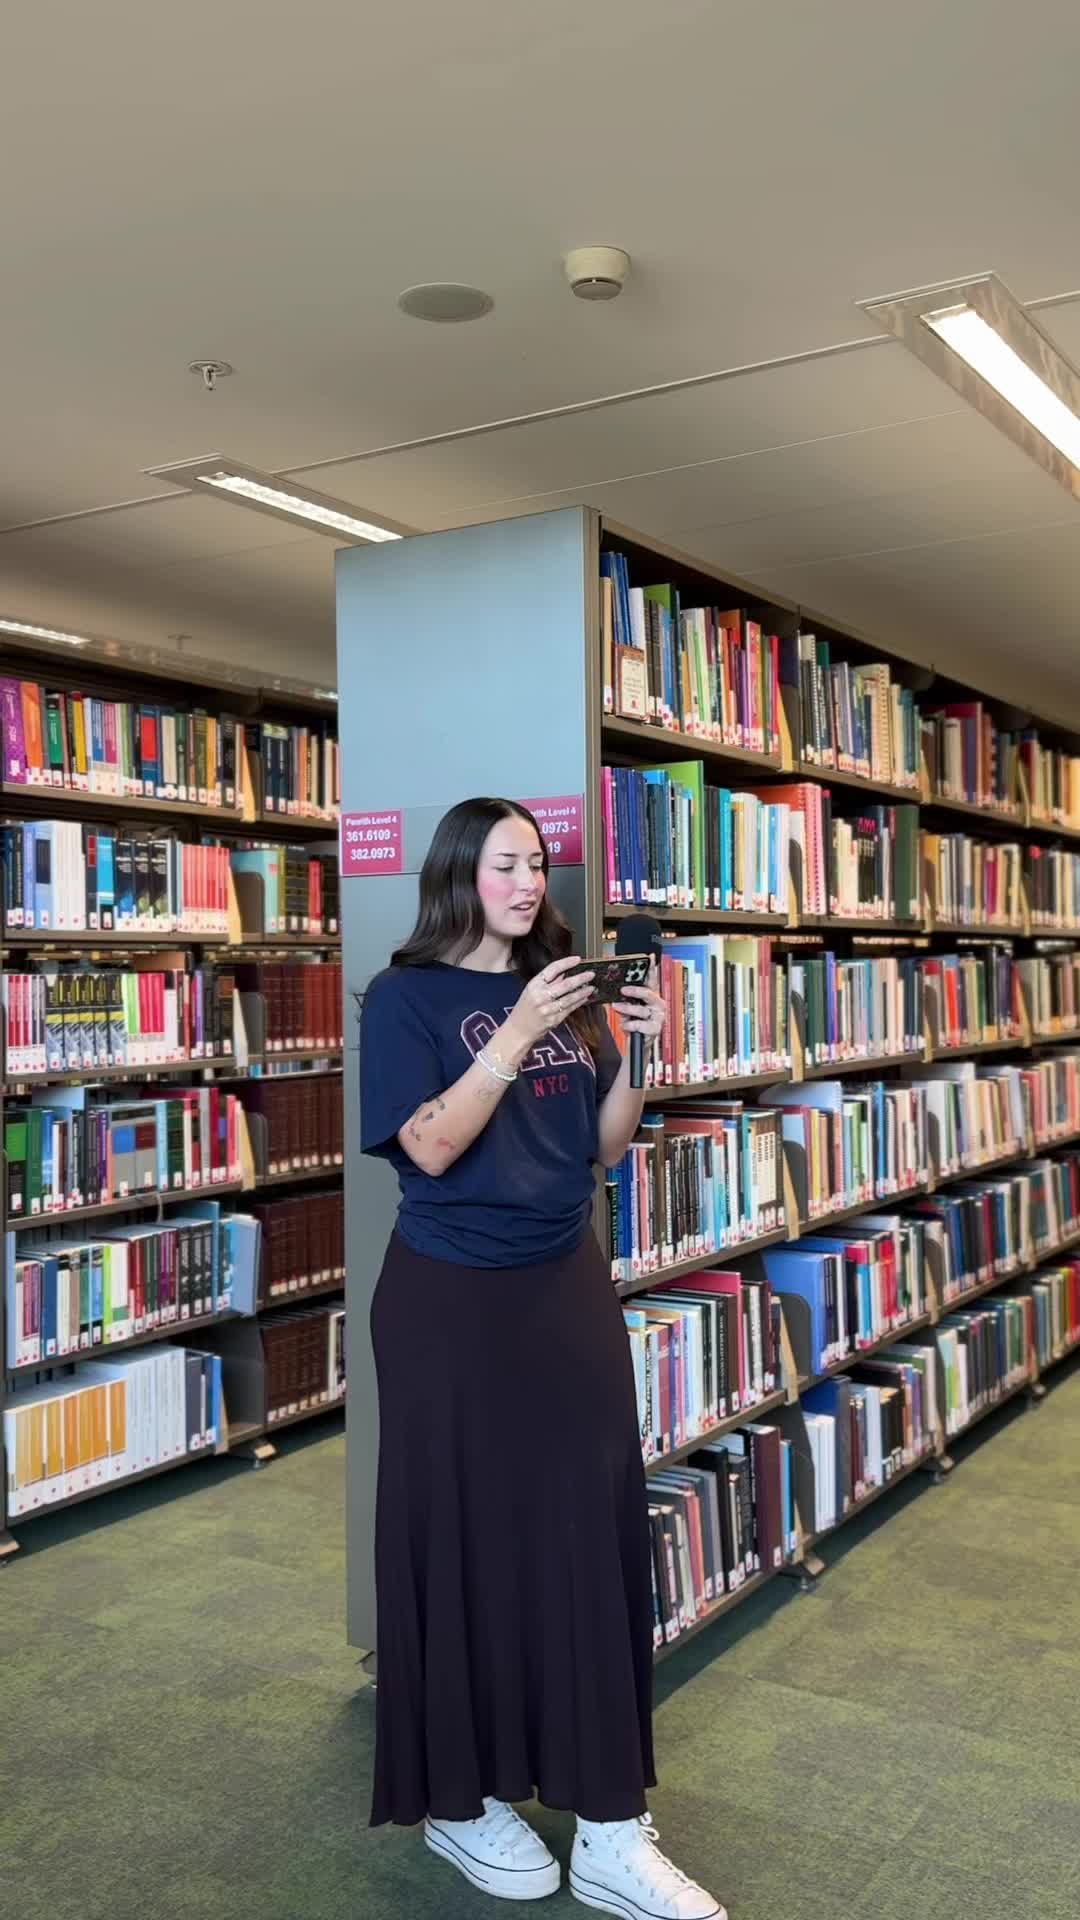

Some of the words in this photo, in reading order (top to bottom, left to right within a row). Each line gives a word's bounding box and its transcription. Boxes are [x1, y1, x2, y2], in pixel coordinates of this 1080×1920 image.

[548, 807, 569, 816] Level
[571, 806, 576, 815] 4
[372, 816, 391, 825] Level
[392, 815, 397, 824] 4
[351, 847, 396, 861] 382.0973
[547, 841, 561, 854] 19
[533, 1074, 569, 1097] NYC
